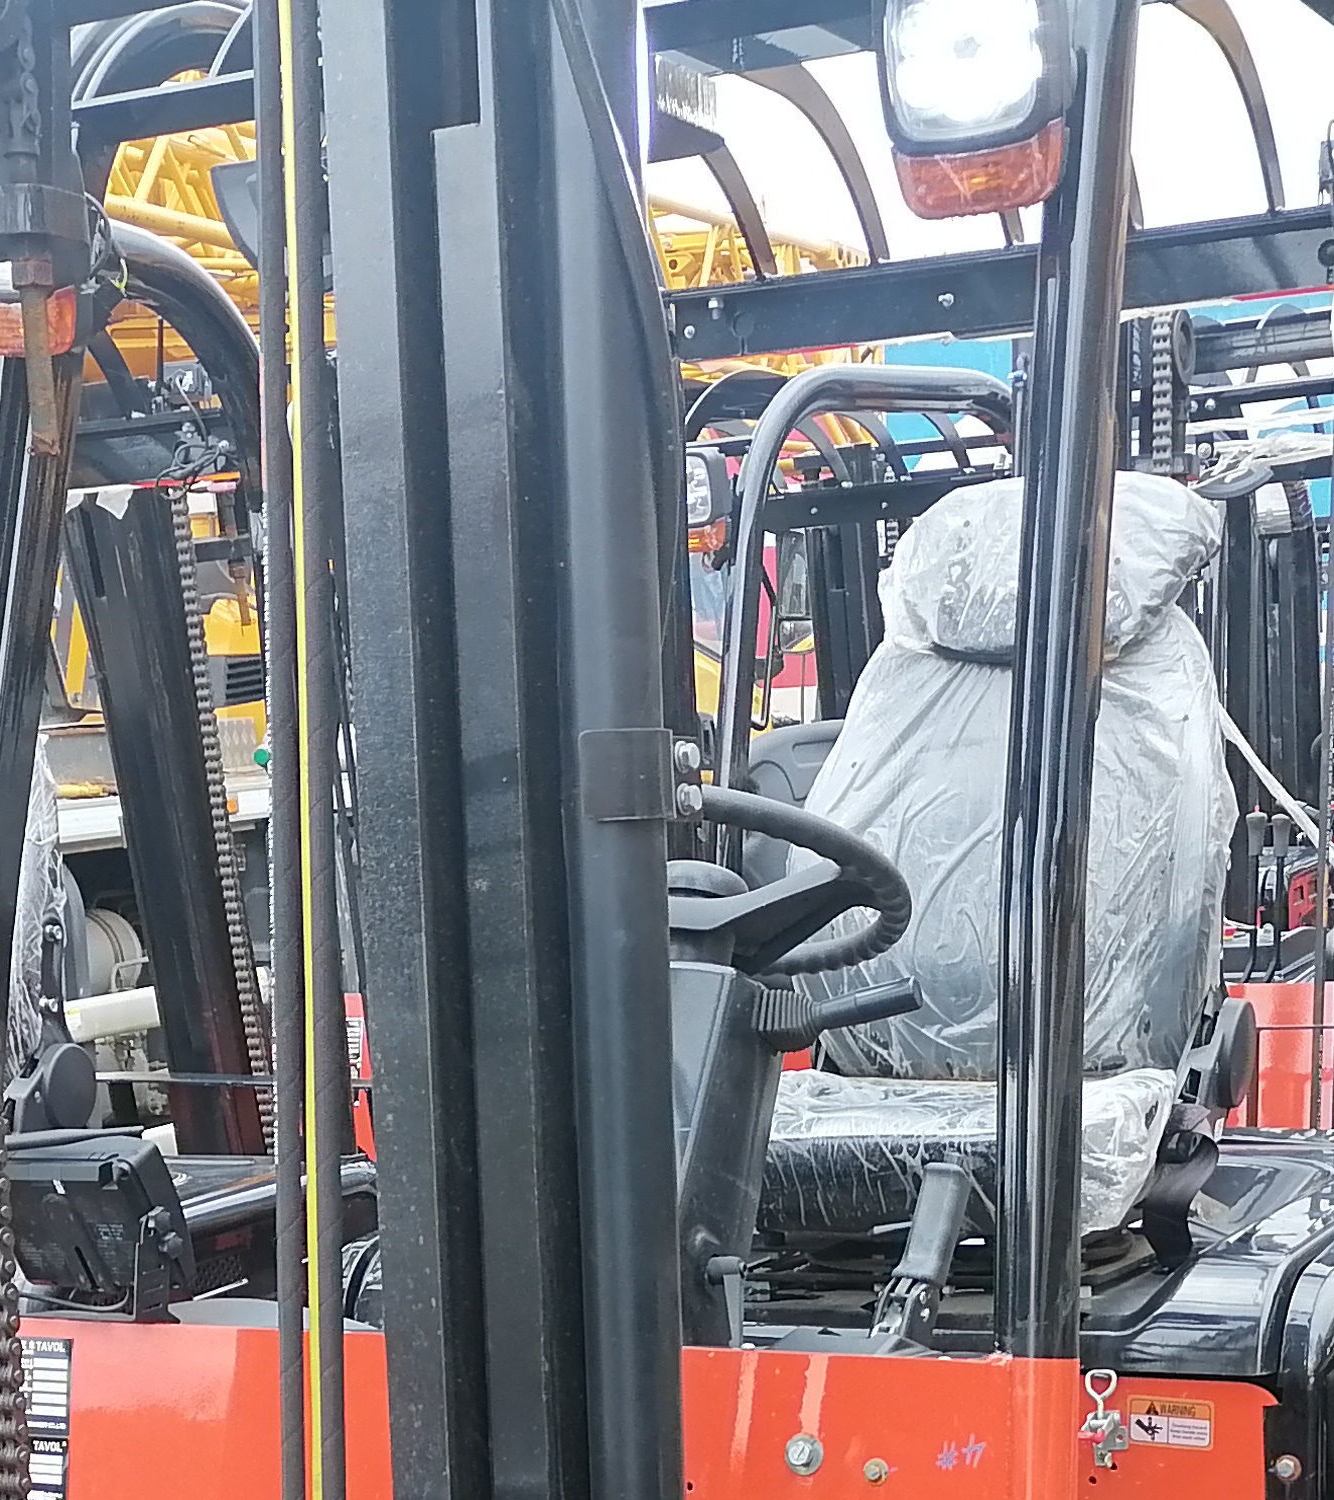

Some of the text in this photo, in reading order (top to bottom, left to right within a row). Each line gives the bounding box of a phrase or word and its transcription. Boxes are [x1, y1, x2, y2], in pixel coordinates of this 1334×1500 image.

[35, 1341, 66, 1352] TAVOL
[1159, 1404, 1197, 1417] WARNING
[32, 1440, 63, 1453] TAVOL
